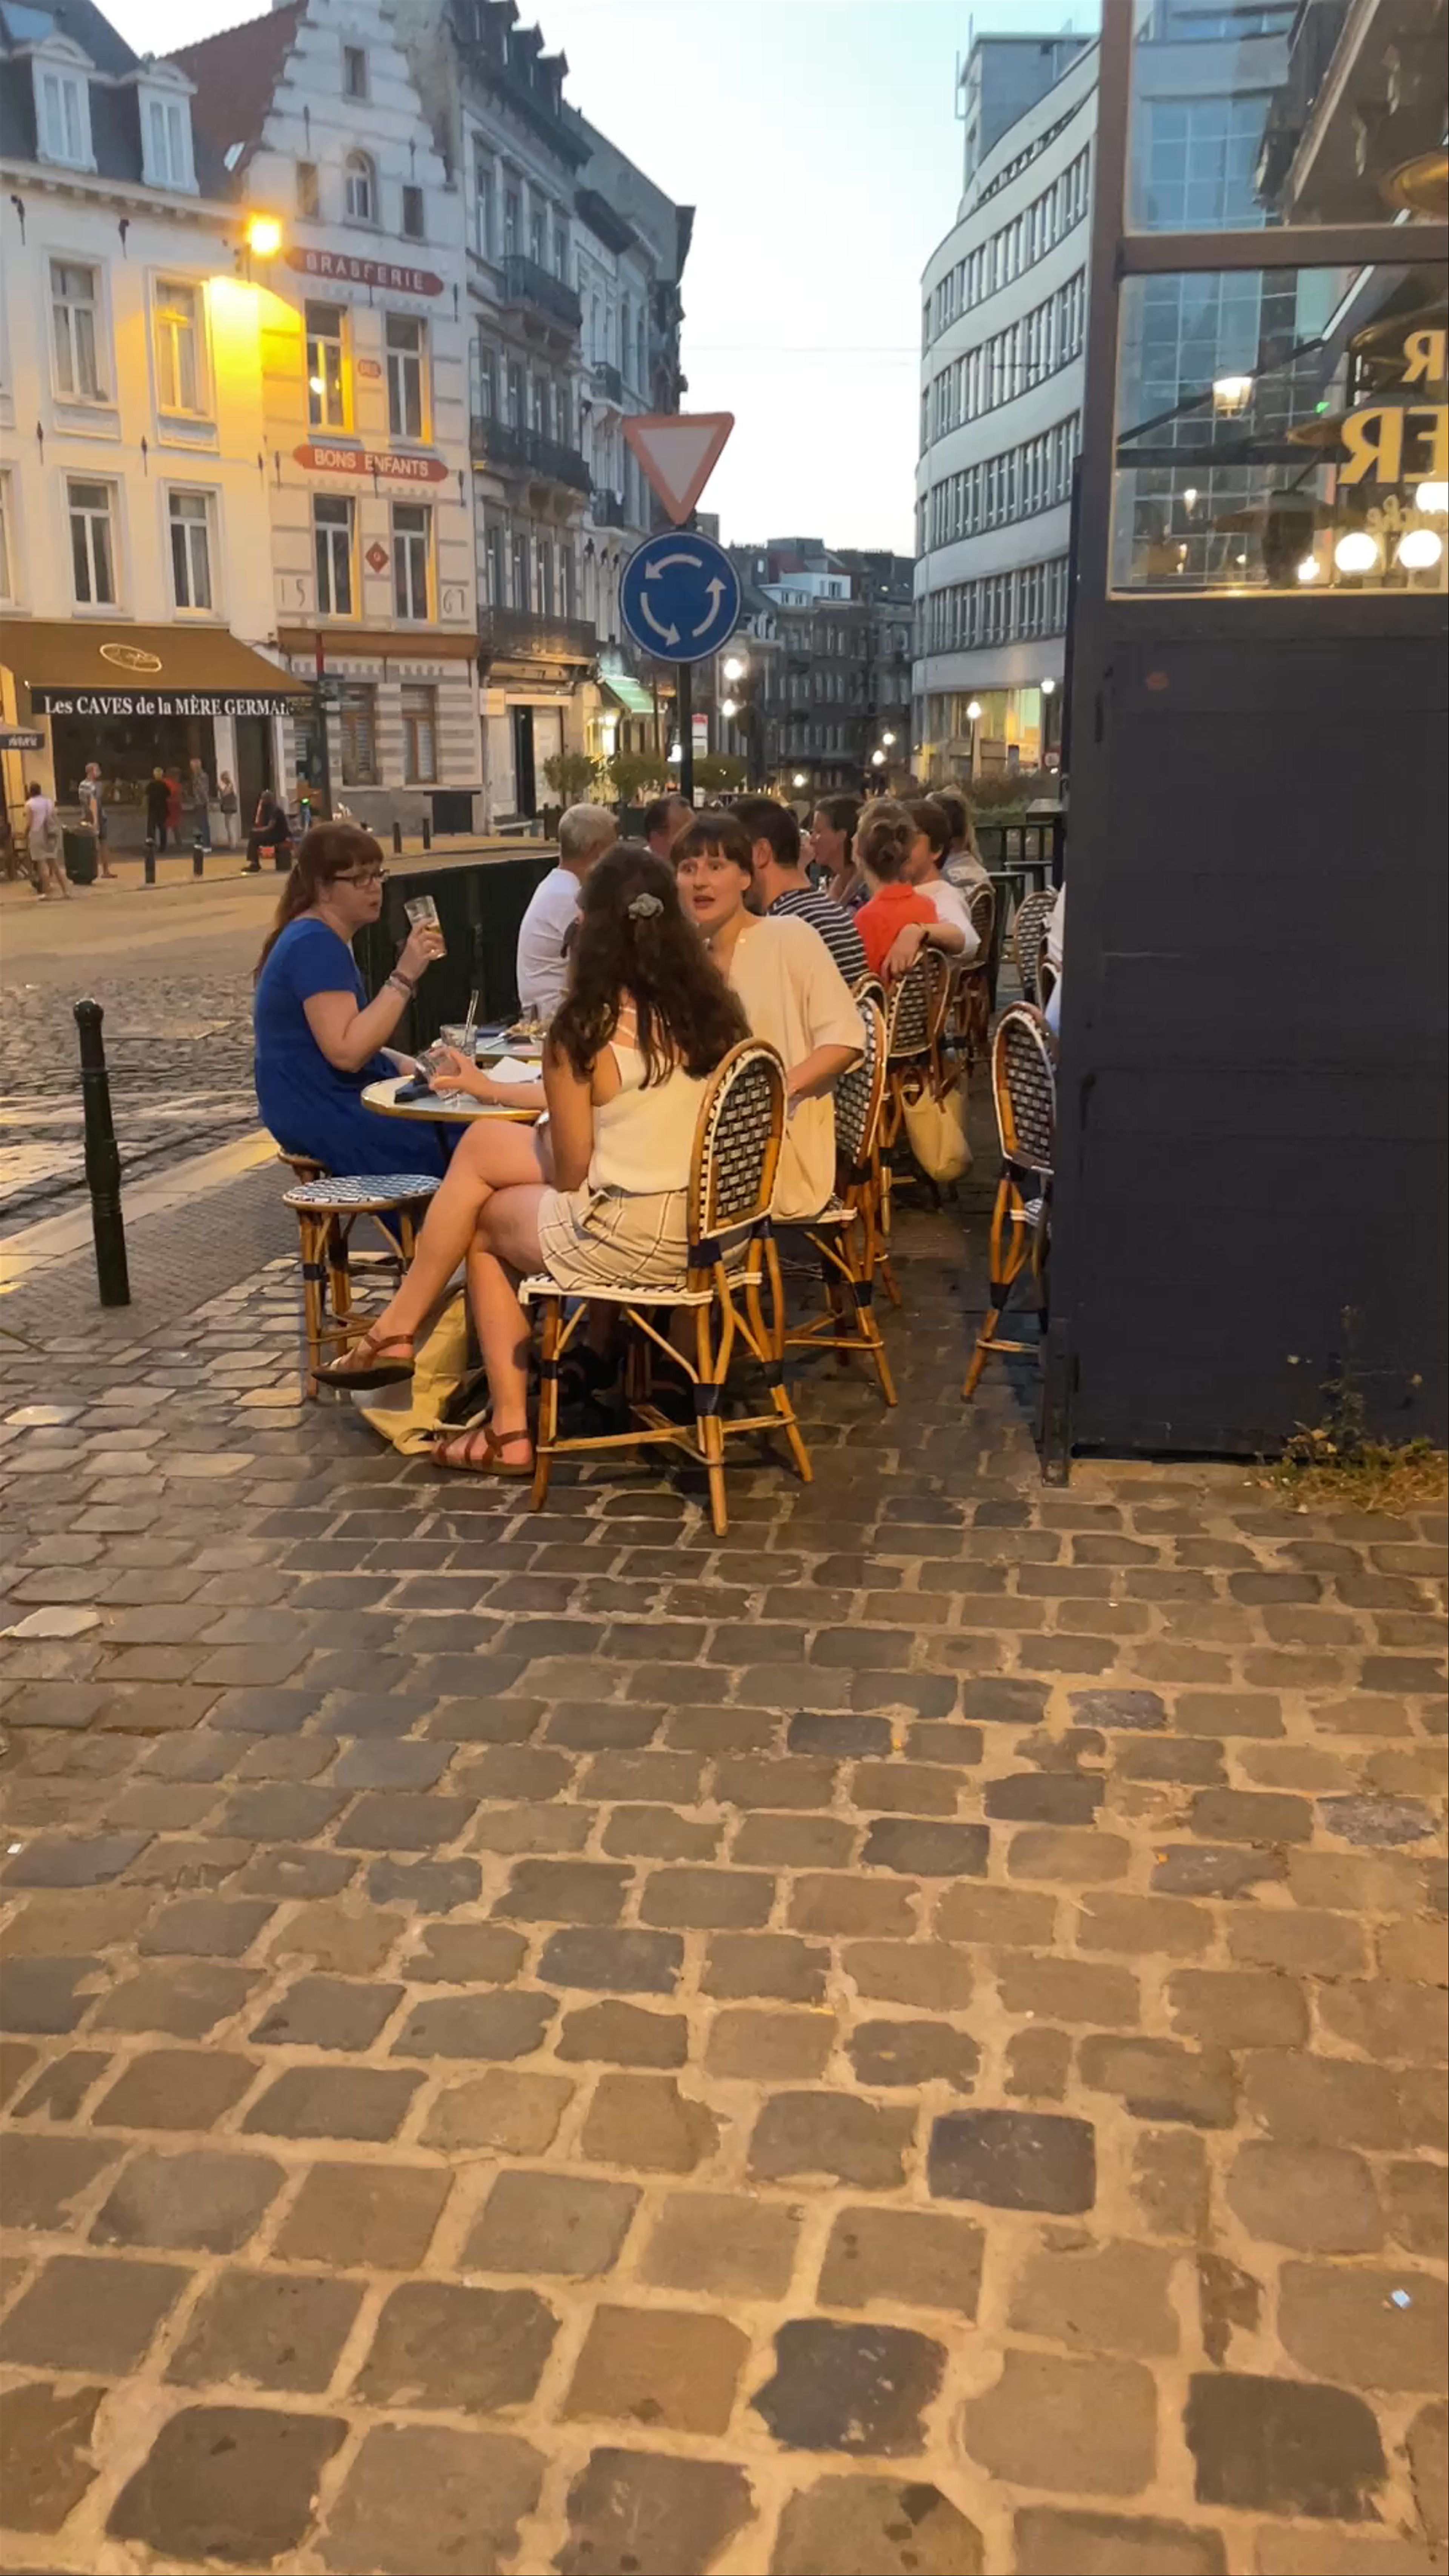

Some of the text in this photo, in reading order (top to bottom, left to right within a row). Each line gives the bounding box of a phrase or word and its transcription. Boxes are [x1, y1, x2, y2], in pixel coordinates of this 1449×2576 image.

[314, 448, 429, 477] BONS ENFANTS
[44, 695, 73, 714] Les
[77, 697, 132, 714] CAVES
[136, 695, 154, 714] de
[157, 697, 172, 714] la
[175, 694, 222, 715] MÈRE
